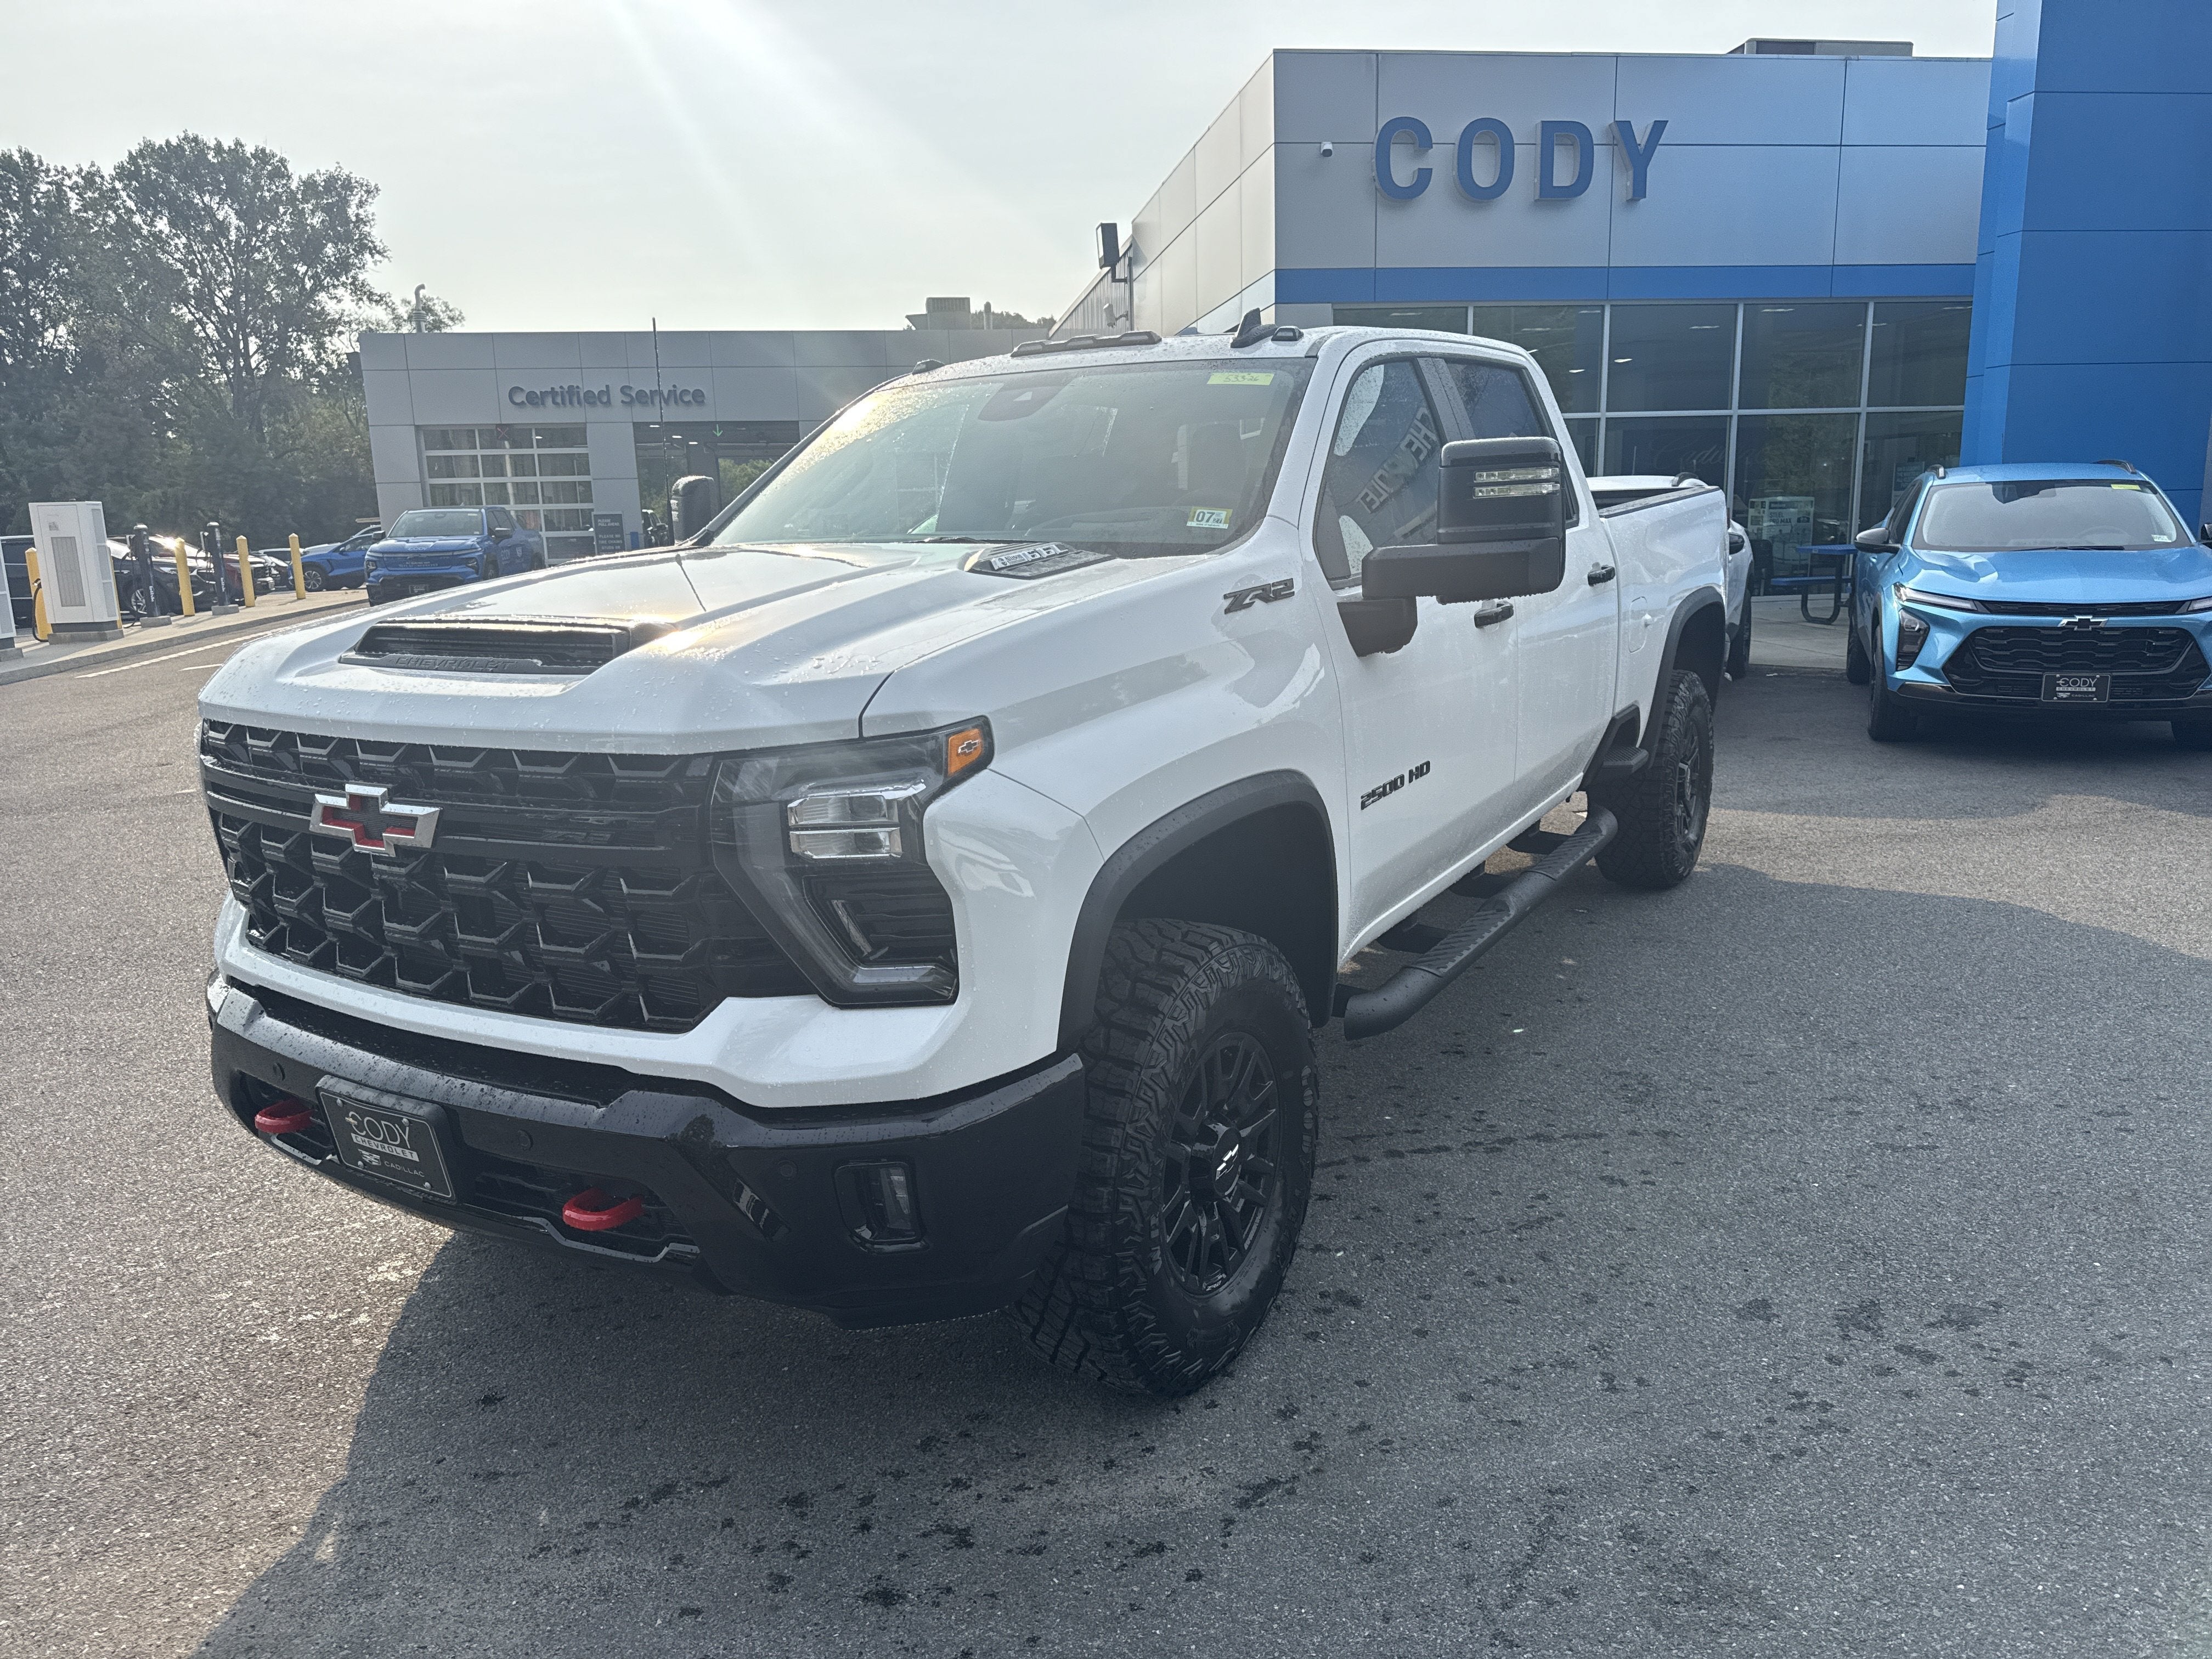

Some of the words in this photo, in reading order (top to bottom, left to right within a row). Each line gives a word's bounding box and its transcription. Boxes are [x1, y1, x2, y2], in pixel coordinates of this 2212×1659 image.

[1374, 116, 1668, 201] CODY
[509, 385, 611, 406] Certified
[620, 385, 706, 405] Service
[1196, 511, 1215, 523] 07
[1223, 578, 1295, 614] ZR2
[2059, 678, 2097, 687] CODY
[1361, 774, 1405, 810] 2500
[1408, 760, 1431, 784] HD
[348, 1111, 410, 1149] CODY
[355, 1136, 416, 1159] CHEVROLET
[384, 1161, 425, 1177] CADILLAC
